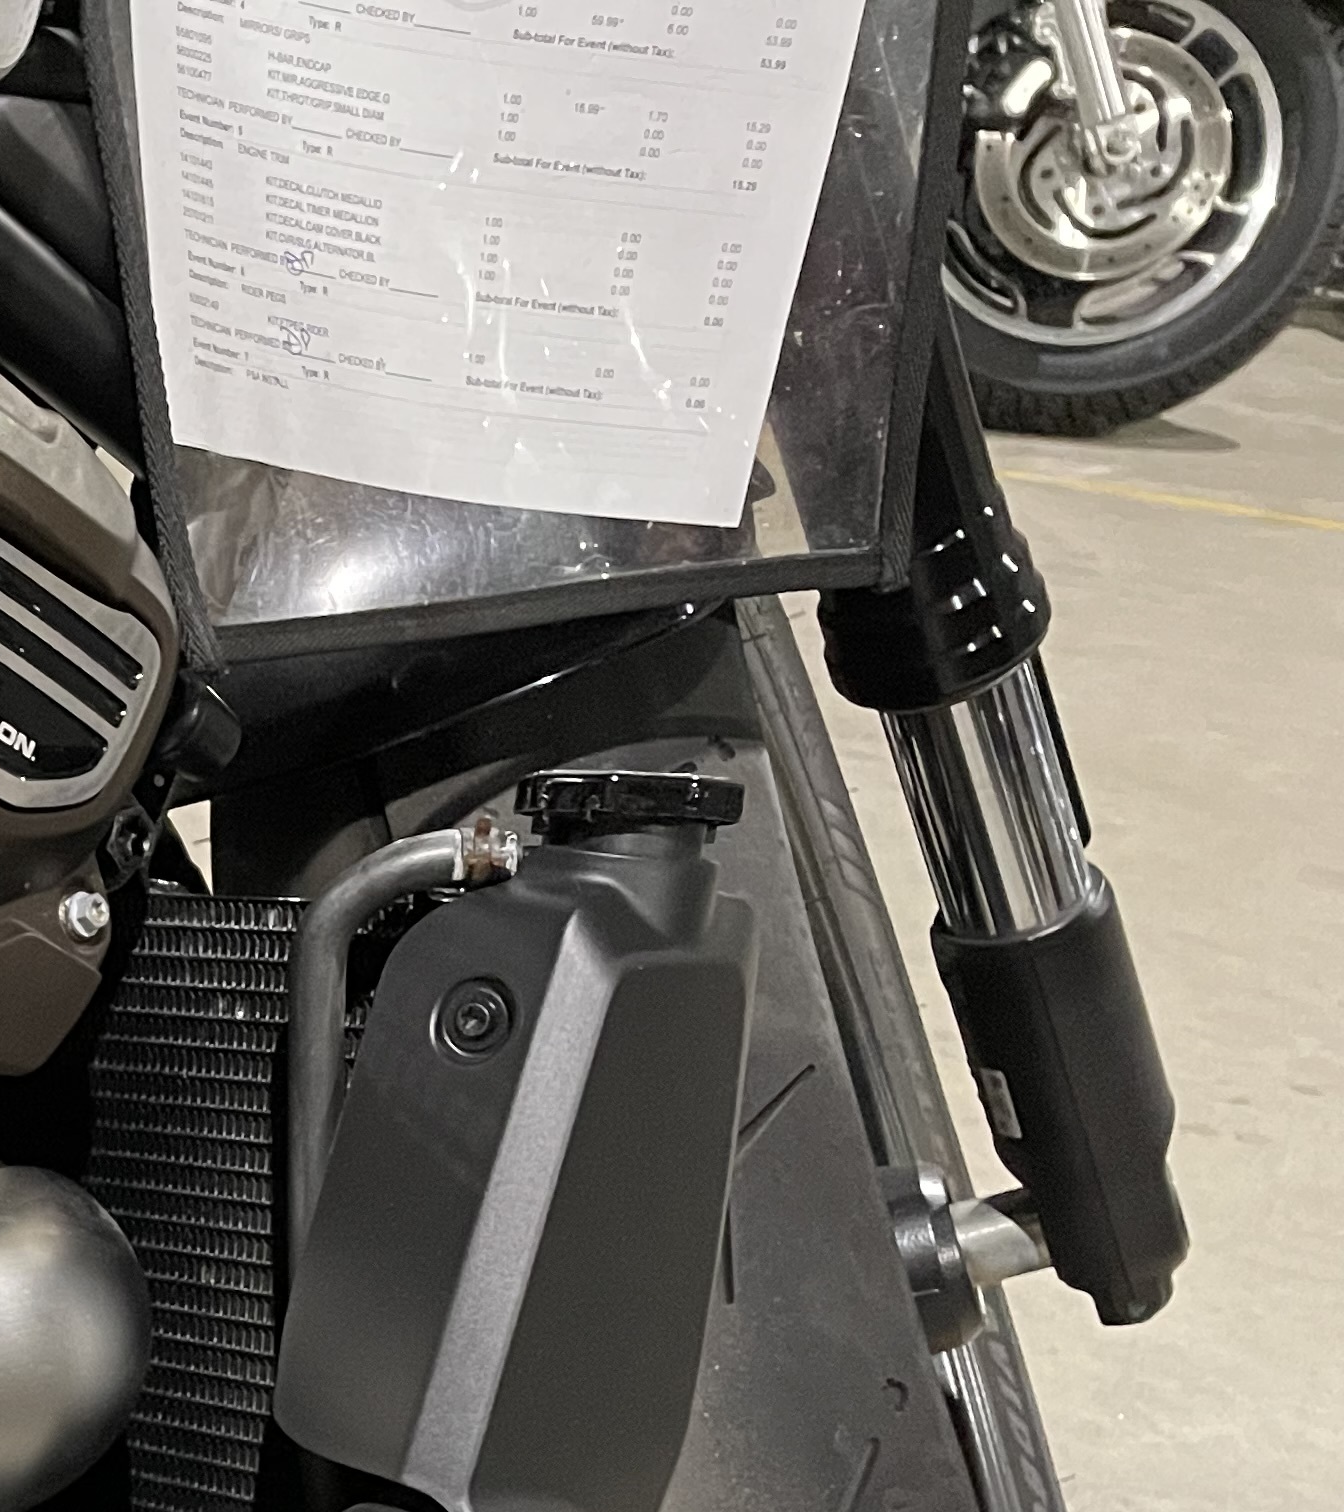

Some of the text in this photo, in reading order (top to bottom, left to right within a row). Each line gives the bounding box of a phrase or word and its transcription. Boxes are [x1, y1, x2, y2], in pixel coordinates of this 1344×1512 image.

[356, 4, 415, 22] CHECKED BY
[518, 6, 537, 17] 1.00
[513, 29, 556, 43] Sub-total
[558, 35, 575, 45] For
[577, 37, 606, 50] Event
[503, 93, 521, 105] 1.00
[500, 112, 519, 123] 1.00
[346, 128, 401, 146] CHECKED BY
[498, 130, 515, 142] 1.00
[493, 153, 533, 167] Sub-total
[535, 158, 551, 169] For
[339, 269, 390, 287] CHECKED BY
[514, 297, 529, 308] For
[532, 299, 556, 310] Event
[520, 382, 544, 394] Event
